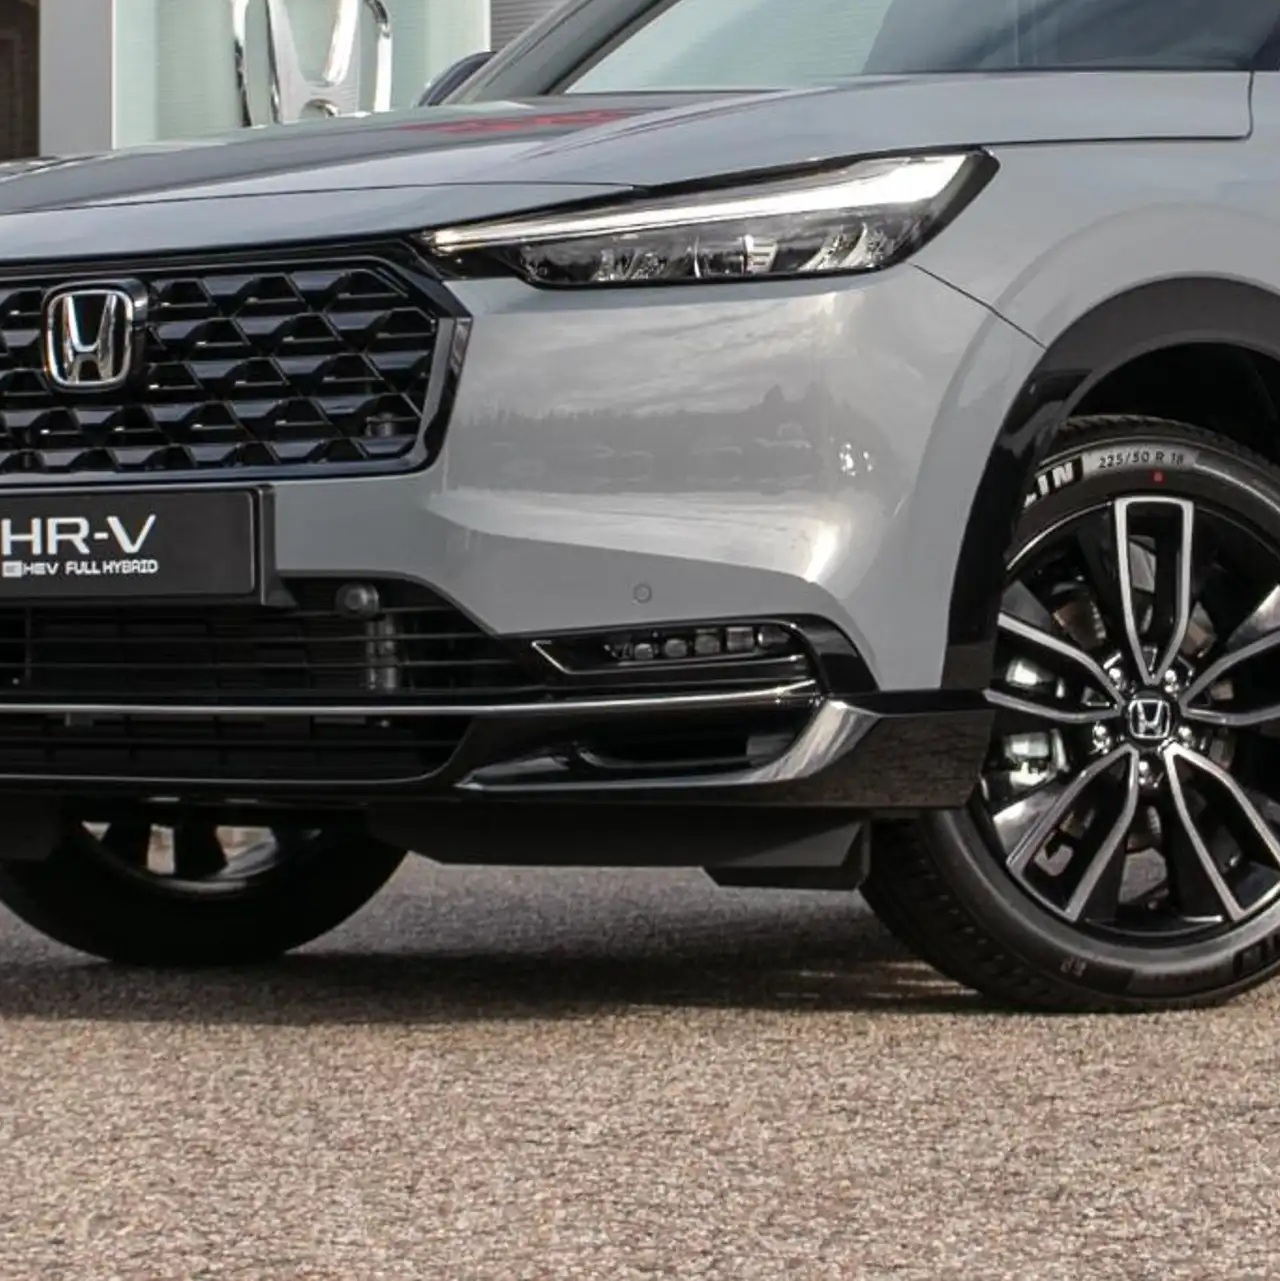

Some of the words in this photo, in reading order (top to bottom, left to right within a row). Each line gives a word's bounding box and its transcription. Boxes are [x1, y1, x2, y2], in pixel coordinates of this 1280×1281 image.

[1155, 451, 1165, 462] R
[1, 514, 157, 556] HR-V
[65, 561, 101, 576] FULL
[102, 559, 159, 575] HYBRID
